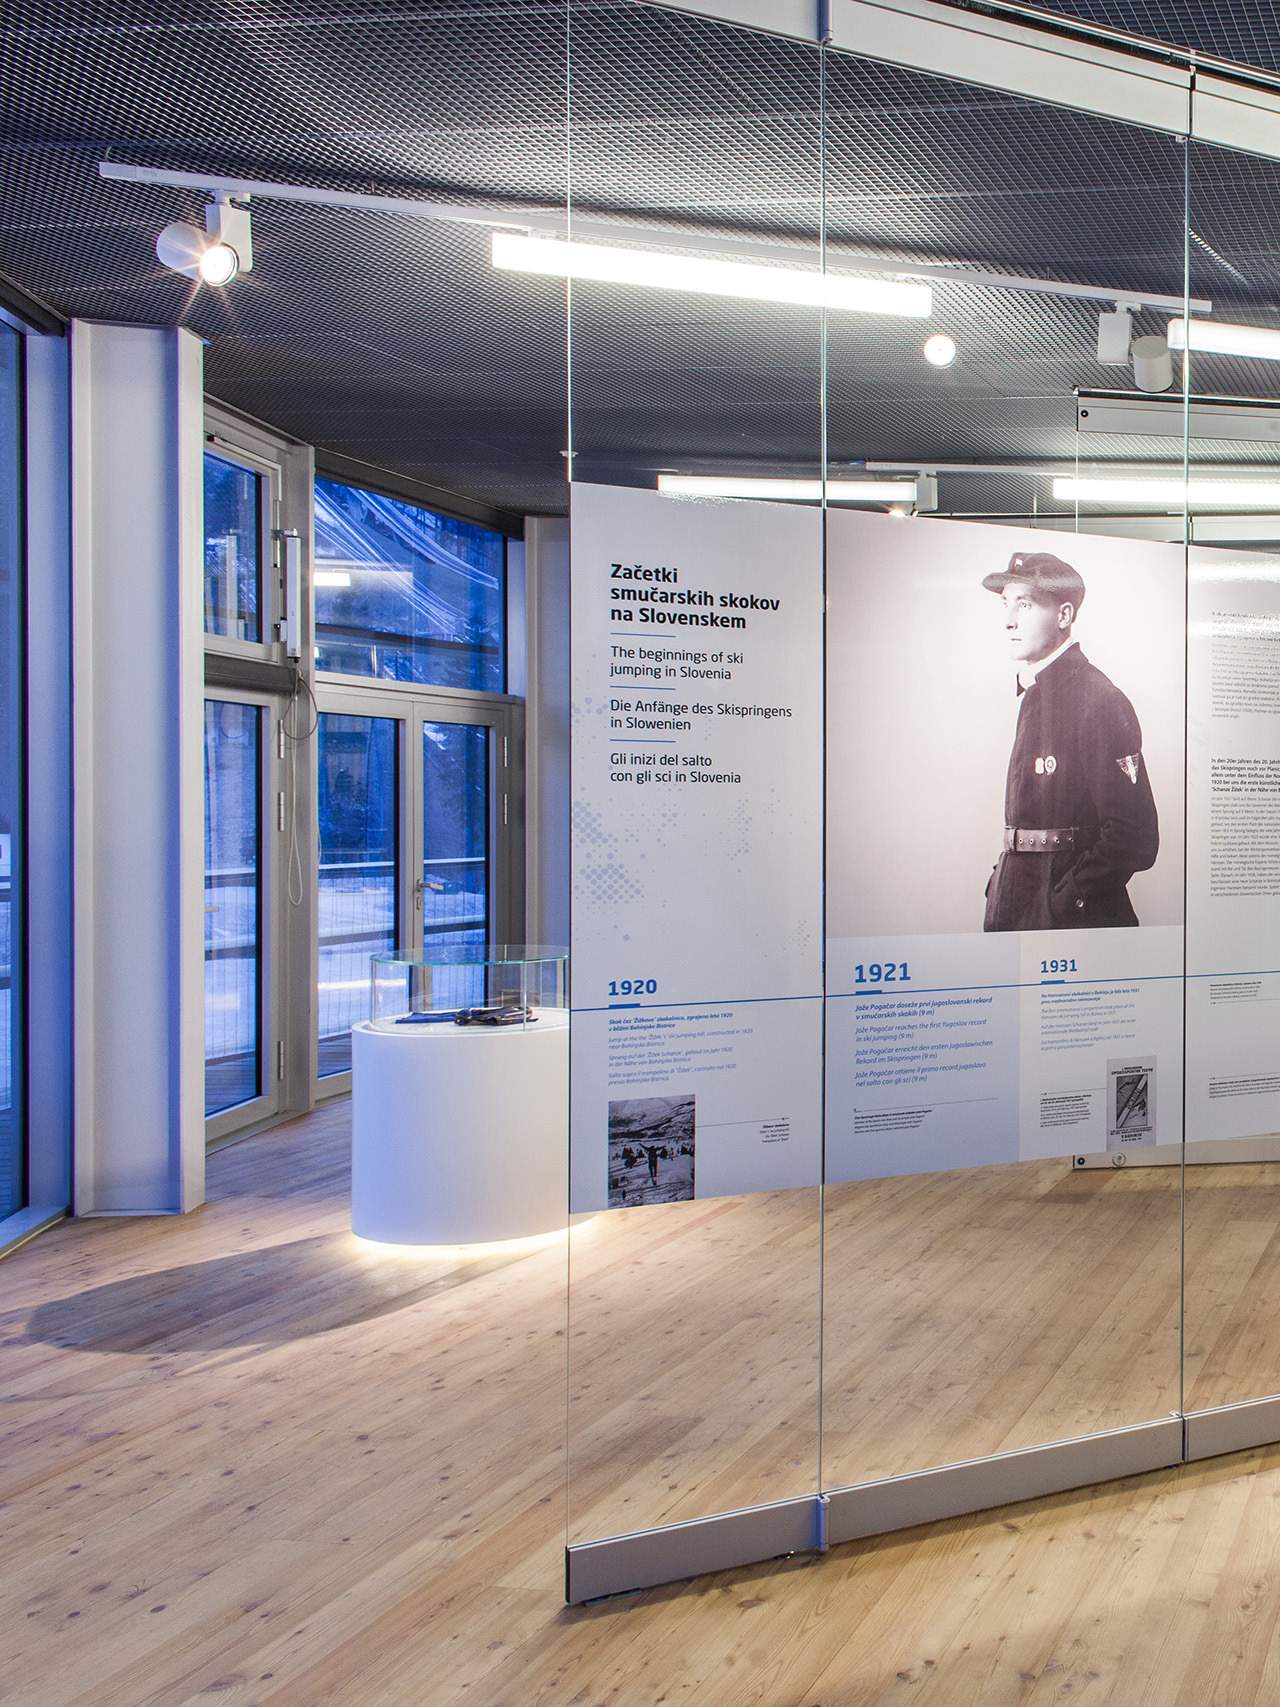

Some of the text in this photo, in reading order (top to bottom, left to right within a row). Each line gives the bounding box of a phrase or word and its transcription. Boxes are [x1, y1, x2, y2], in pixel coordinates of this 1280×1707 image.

[610, 564, 678, 583] Začetki
[610, 588, 780, 611] smučarskih skokov
[611, 608, 746, 629] na Slovenskem
[610, 645, 744, 664] The beginnings of ski
[609, 663, 732, 680] jumping in Slovenia
[610, 699, 792, 719] Die Anfänge des Skispringens
[610, 716, 691, 730] in Slowenien
[610, 752, 712, 767] Gli inizi del salto
[610, 770, 741, 785] con gli sci in Slovenia
[854, 962, 911, 983] 1921
[1040, 959, 1077, 973] 1931
[608, 979, 657, 996] 1920
[855, 1004, 869, 1012] Jože
[870, 1003, 896, 1011] Pogačar
[918, 1000, 931, 1009] prvi
[931, 998, 973, 1008] jugoslovanski
[861, 1011, 897, 1020] smučarskih
[854, 1027, 869, 1035] Jože
[869, 1025, 894, 1034] Pogačar
[942, 1020, 968, 1029] Yugoslav
[871, 1034, 898, 1043] jumping
[854, 1049, 869, 1057] Jože
[869, 1047, 894, 1056] Pogačar
[894, 1045, 918, 1053] erreicht
[948, 1040, 993, 1050] jugoslawischen
[887, 1055, 921, 1063] Skispringen
[854, 1071, 868, 1079] Jože
[869, 1069, 894, 1078] Pogačar
[920, 1066, 939, 1074] primo
[958, 1062, 987, 1071] jugoslavo
[894, 1077, 902, 1085] gli
